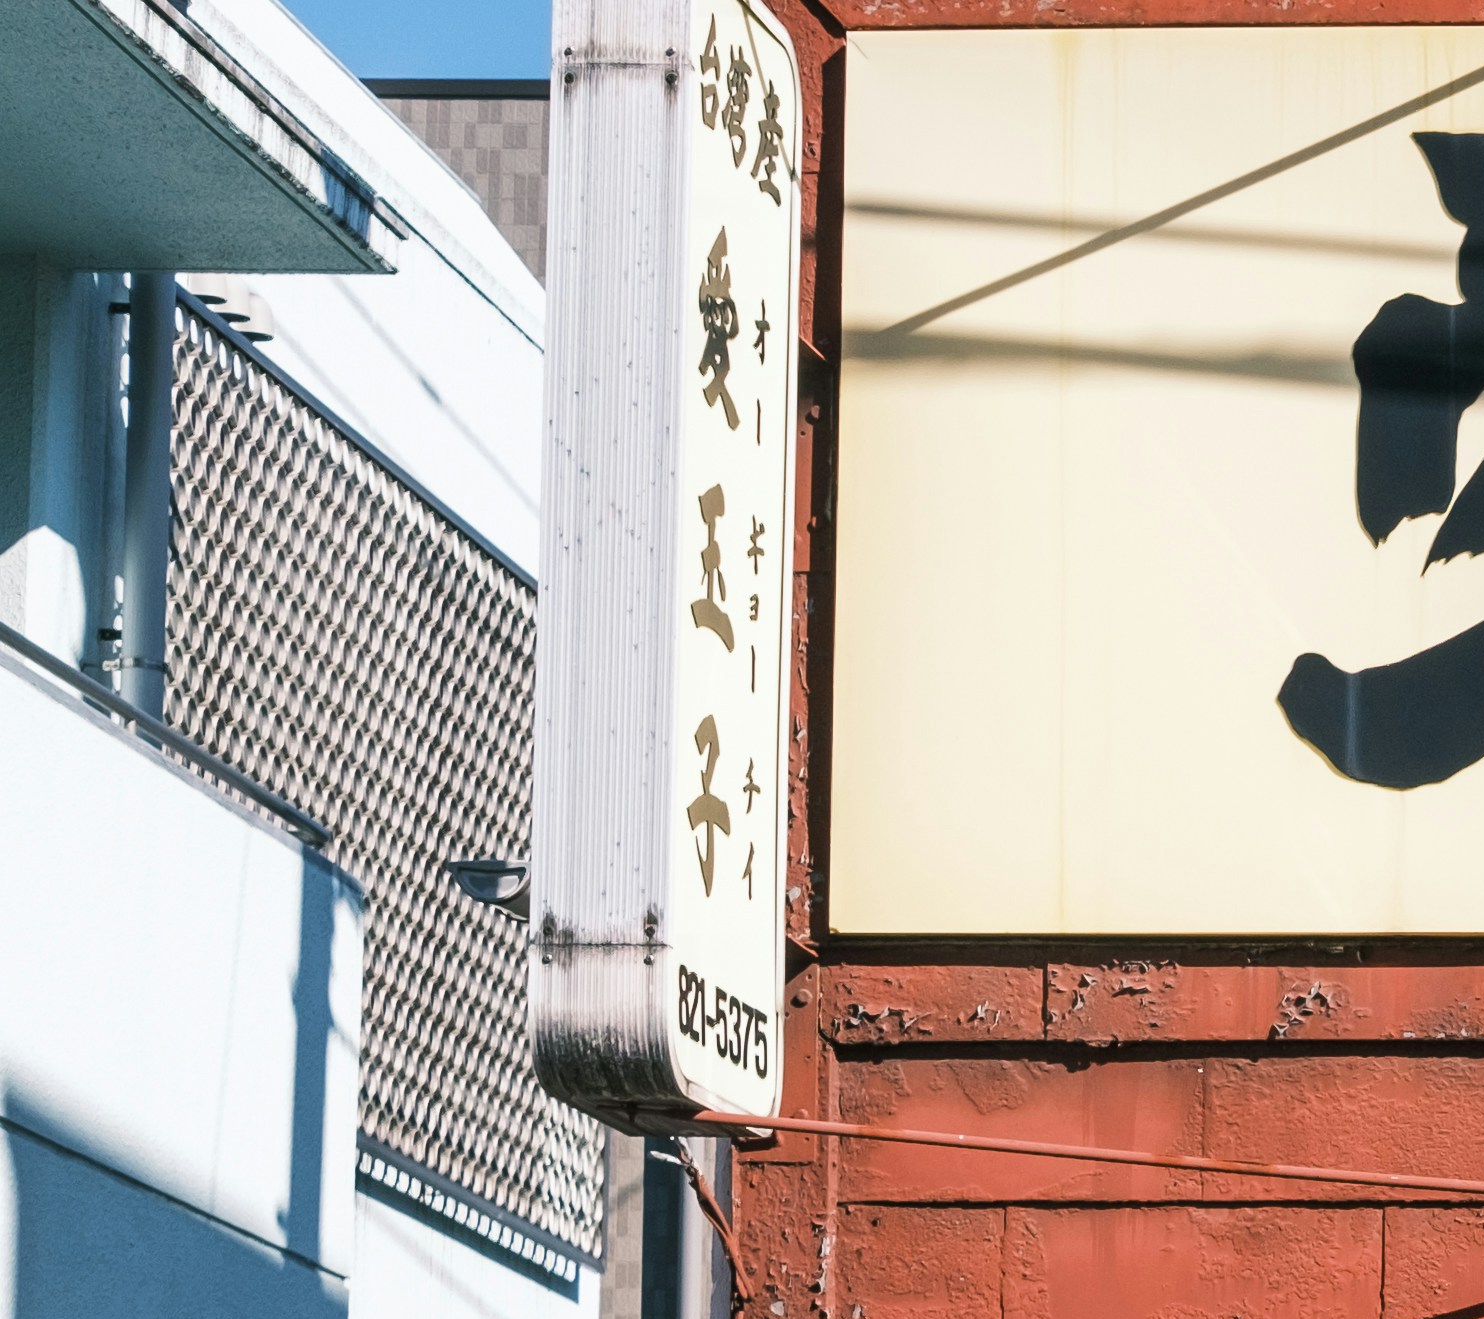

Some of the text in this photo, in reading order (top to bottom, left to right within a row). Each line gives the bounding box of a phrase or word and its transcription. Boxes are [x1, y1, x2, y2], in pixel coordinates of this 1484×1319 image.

[699, 12, 782, 206] 台湾産
[685, 224, 740, 898] 愛玉子
[677, 962, 769, 1078] 821-5375
